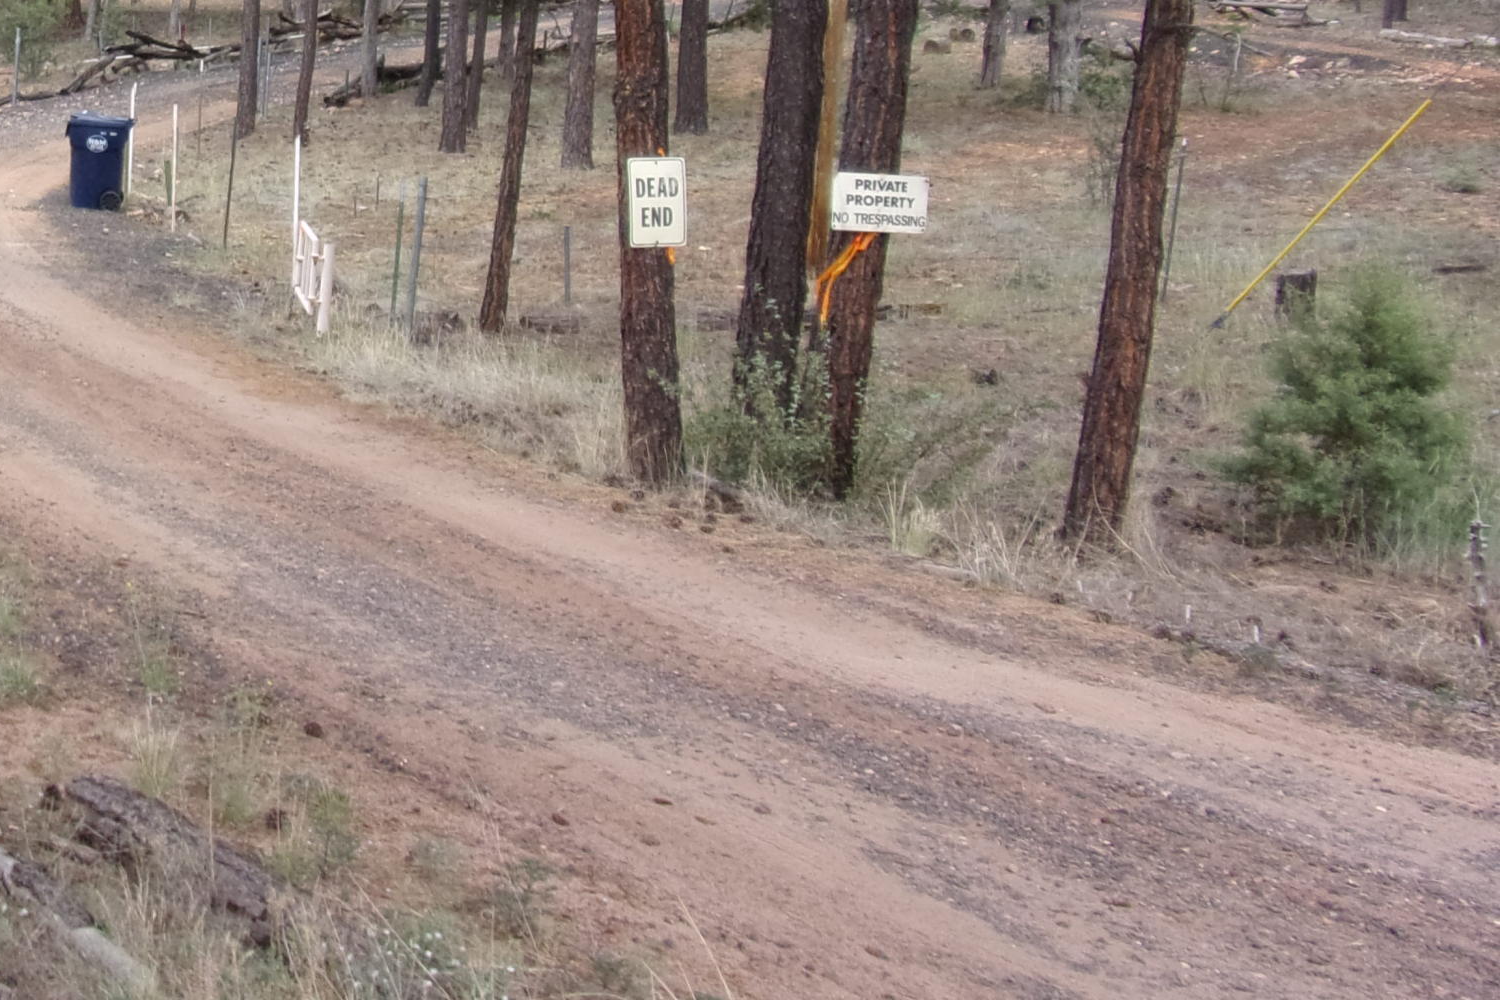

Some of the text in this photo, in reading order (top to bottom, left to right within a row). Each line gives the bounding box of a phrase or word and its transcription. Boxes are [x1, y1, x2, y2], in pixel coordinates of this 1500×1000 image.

[635, 176, 679, 198] DEAD
[854, 178, 908, 193] PRIVATE
[846, 194, 915, 209] PROPERTY
[641, 206, 673, 228] END
[832, 211, 926, 228] NO TRESPASSING
